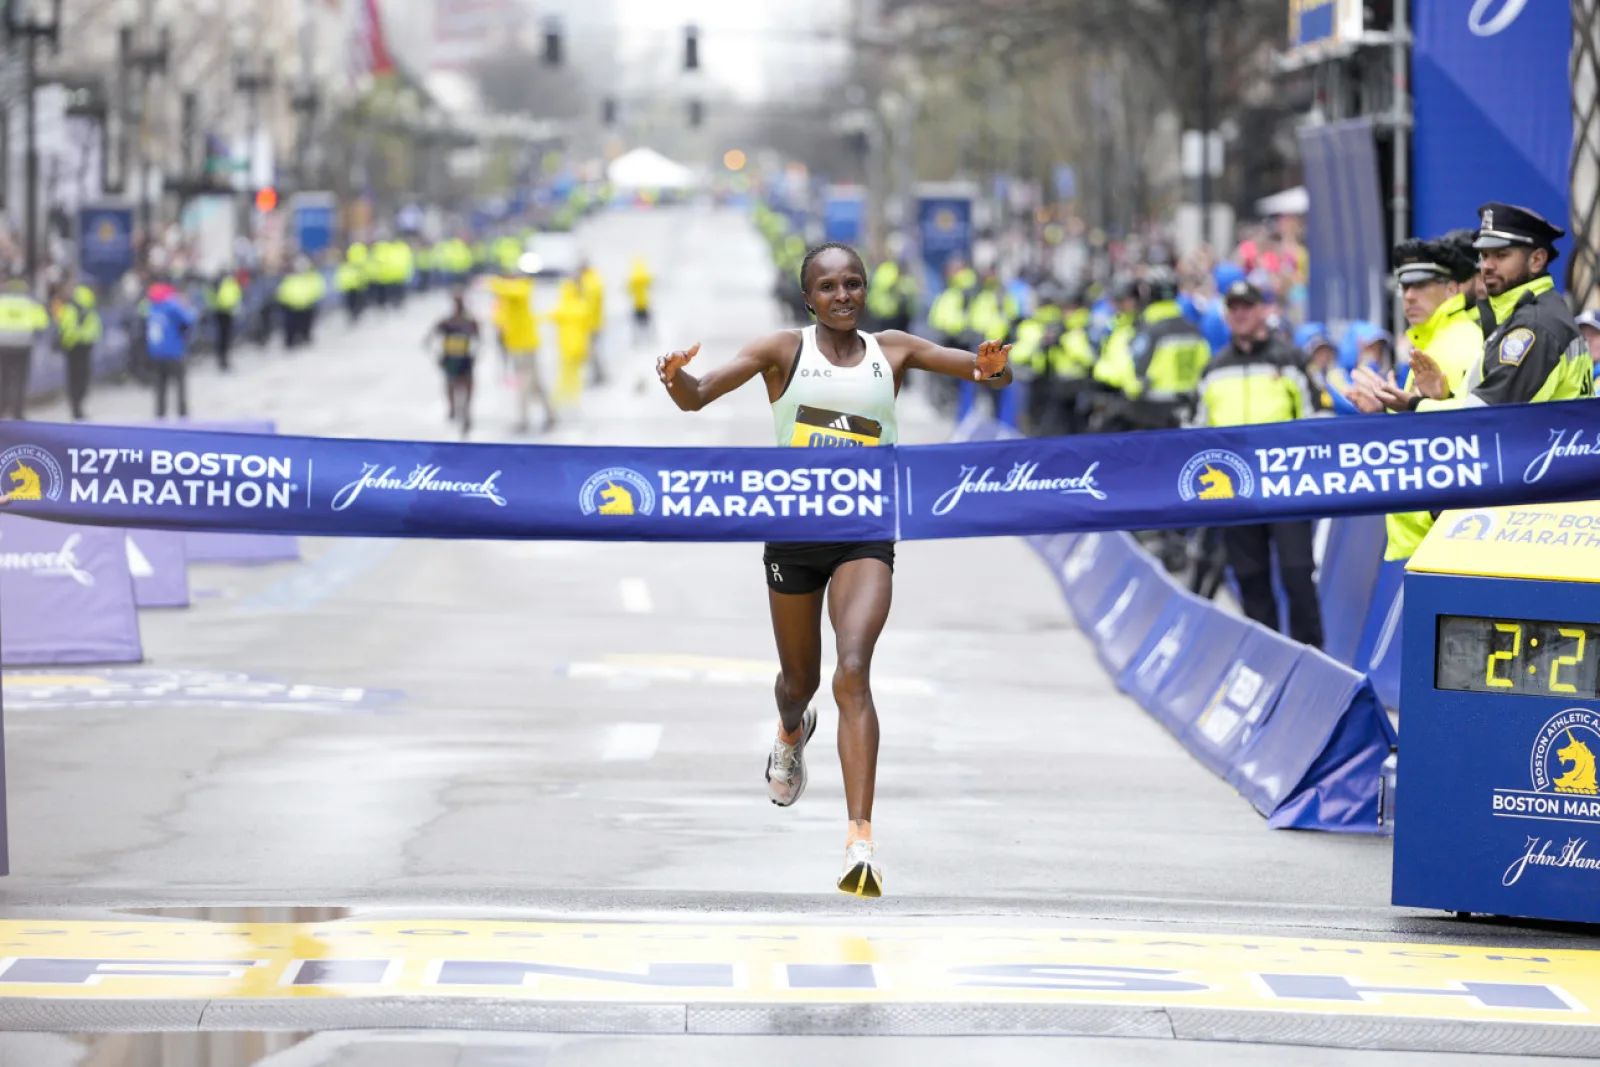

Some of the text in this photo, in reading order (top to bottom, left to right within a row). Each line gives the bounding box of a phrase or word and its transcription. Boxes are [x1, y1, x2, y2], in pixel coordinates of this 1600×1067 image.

[67, 448, 291, 479] 127TH BOSTON
[1255, 434, 1480, 473] 127TH BOSTON
[1523, 428, 1591, 484] John
[70, 478, 290, 508] MARATHON
[331, 462, 508, 511] John Hancock
[658, 469, 734, 493] 127TH
[741, 468, 882, 493] BOSTON
[932, 461, 1107, 516] John Hancock
[1261, 462, 1483, 499] MARATHON
[662, 494, 883, 517] MARATHON
[1506, 511, 1558, 526] 127TH
[1535, 736, 1548, 786] BOSTON
[1547, 713, 1590, 737] ATHLETIC
[1493, 795, 1600, 817] BOSTON MAR
[1502, 835, 1556, 887] John
[0, 957, 1580, 1011] FINISH
